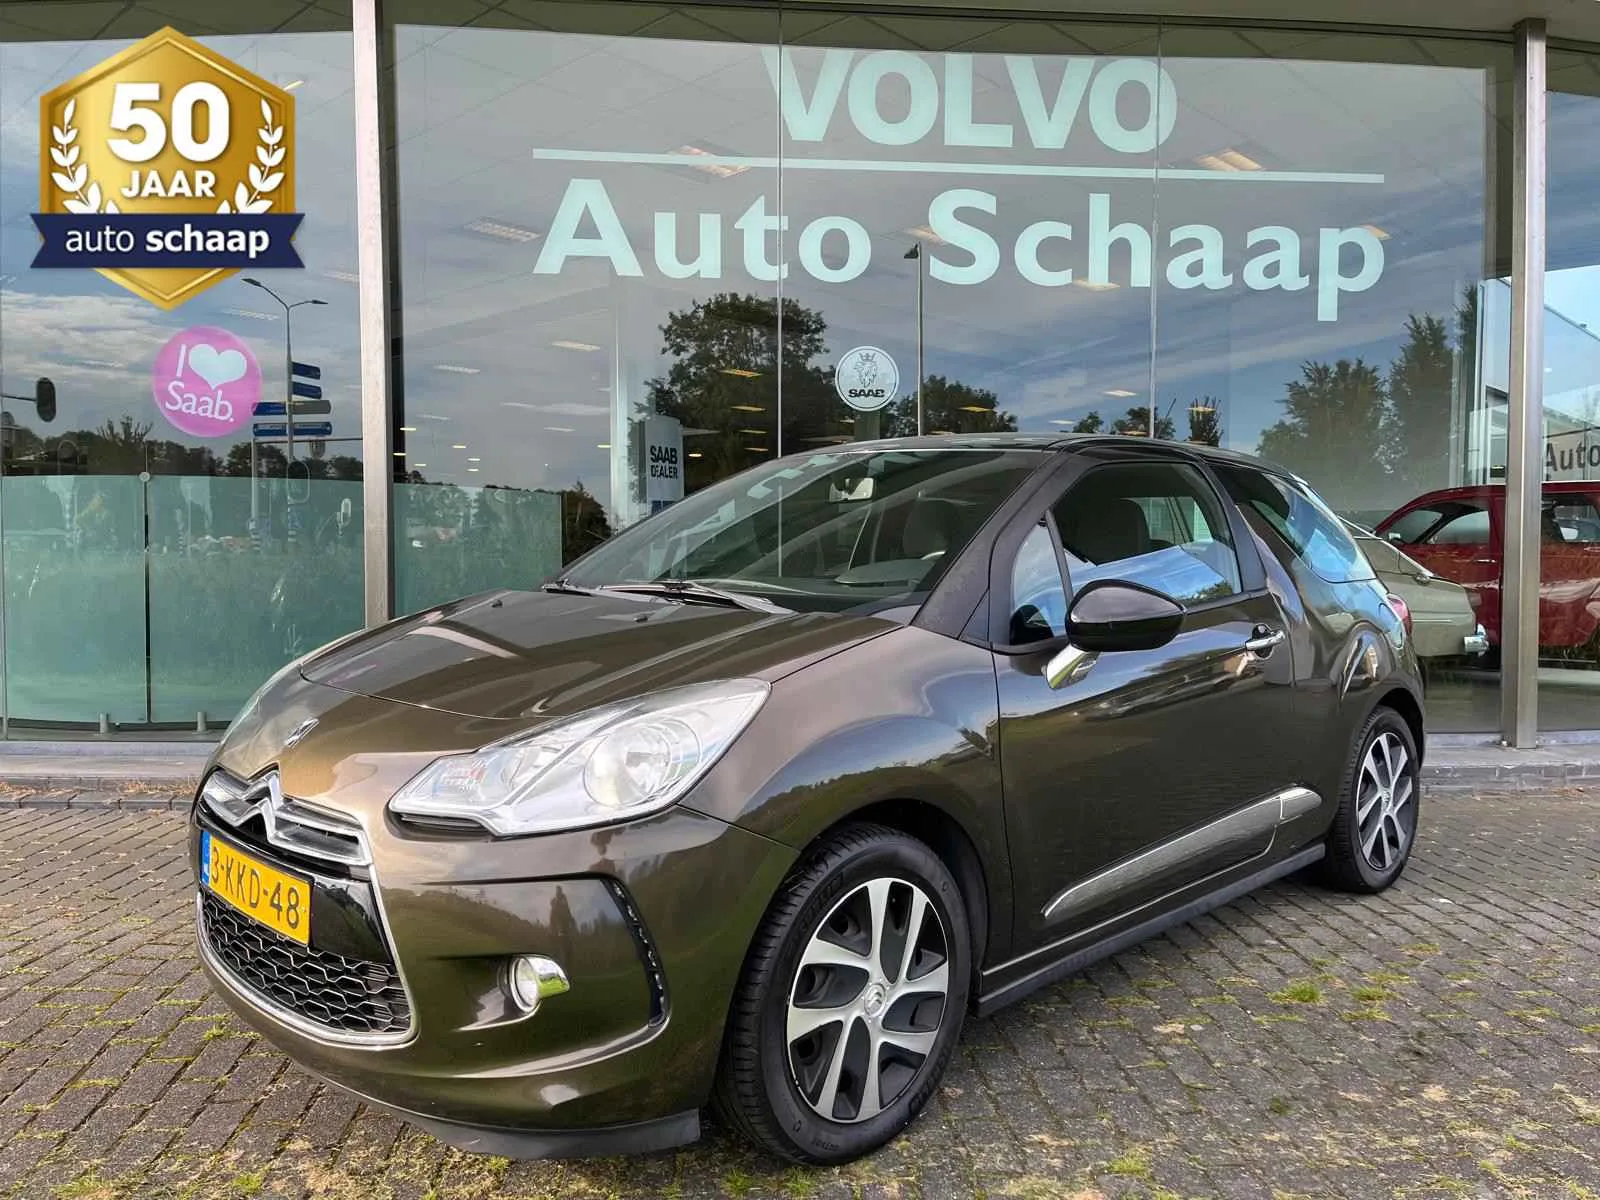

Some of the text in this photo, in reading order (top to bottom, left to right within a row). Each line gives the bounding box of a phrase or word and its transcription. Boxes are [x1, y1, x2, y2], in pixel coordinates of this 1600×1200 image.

[760, 46, 1178, 153] VOLVO
[532, 178, 1385, 322] Auto Schaap
[176, 343, 187, 377] I
[165, 380, 235, 422] Saab.
[848, 388, 885, 398] SAAB
[649, 444, 678, 465] SAAB
[650, 463, 678, 480] DEALER
[211, 846, 300, 930] 3-KKD-48
